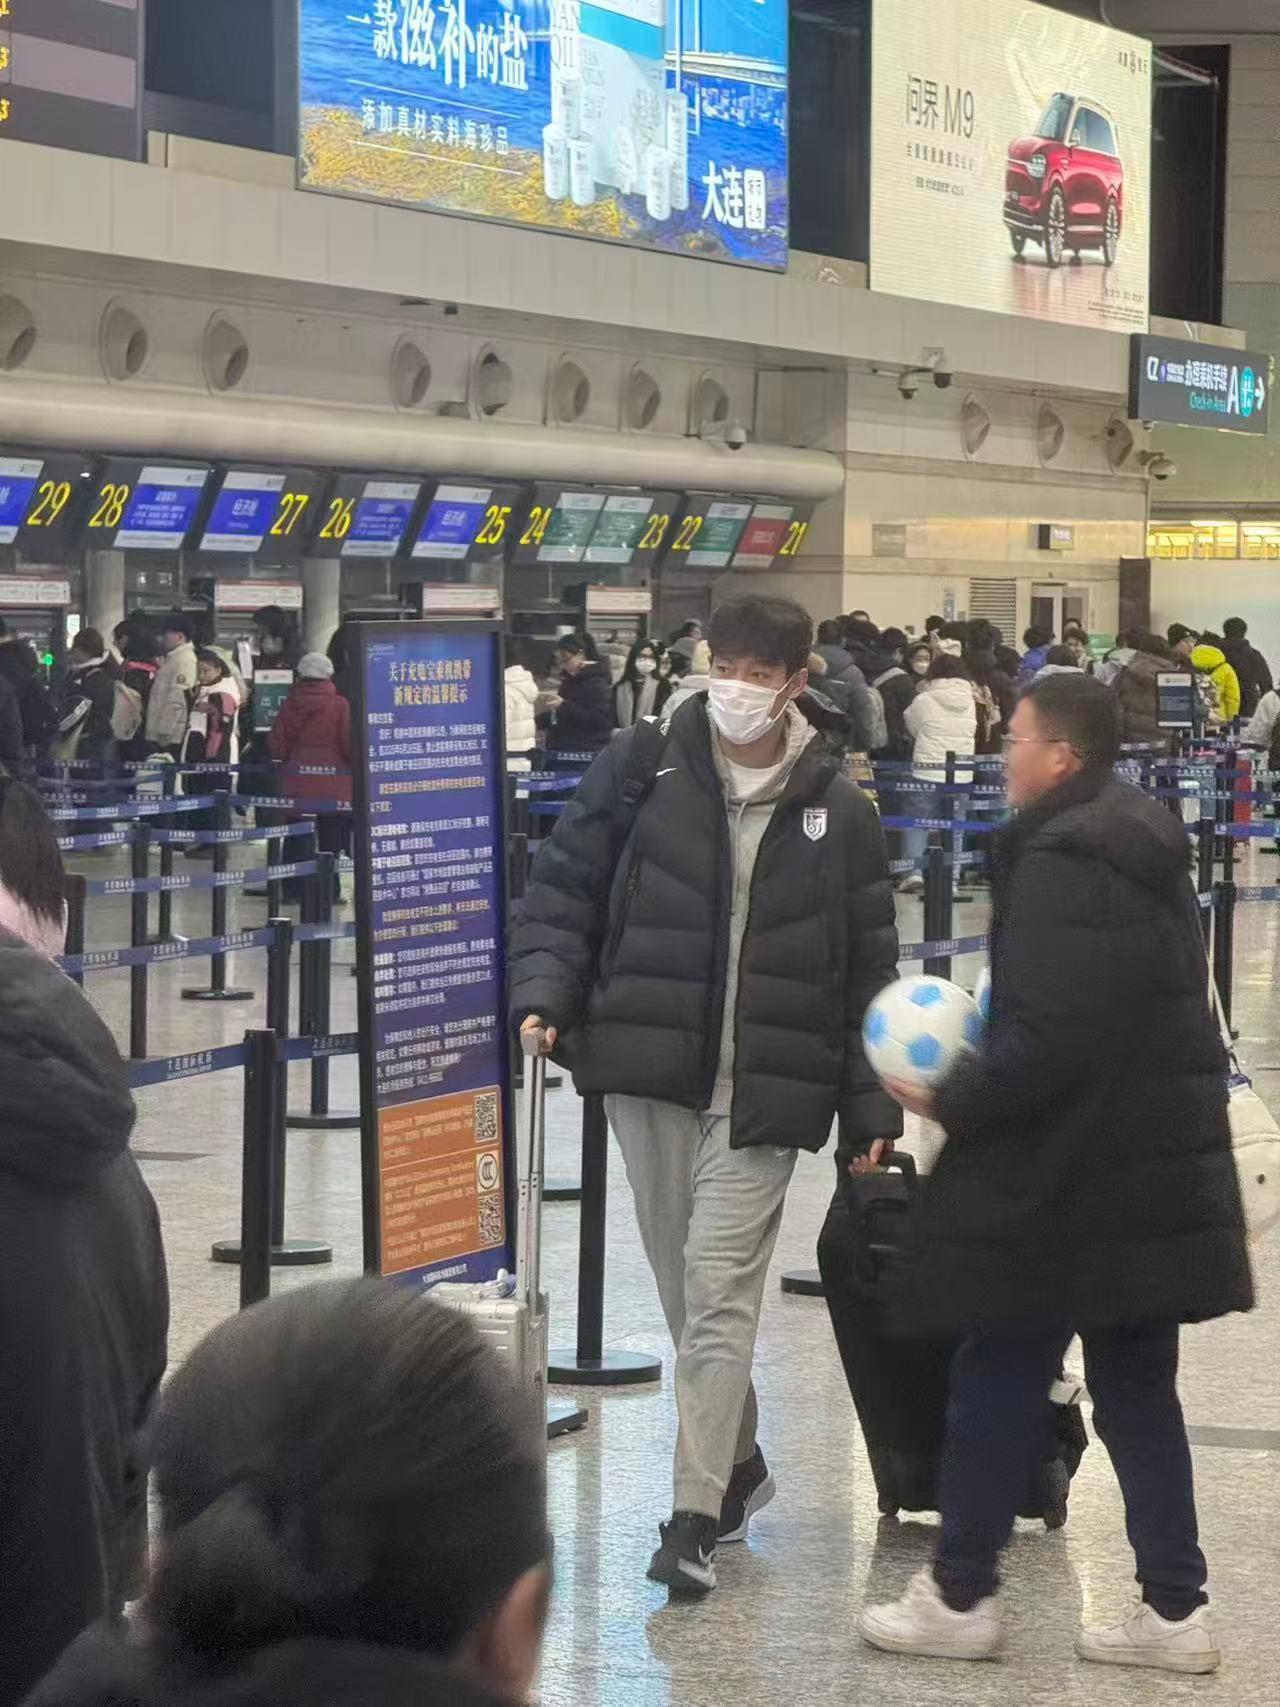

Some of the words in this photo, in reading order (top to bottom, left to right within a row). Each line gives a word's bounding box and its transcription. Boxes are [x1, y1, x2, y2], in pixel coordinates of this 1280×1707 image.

[346, 0, 528, 90] 一款滋补的盐
[362, 96, 508, 155] 添加真材实料海珍品
[906, 73, 939, 130] 问界
[944, 84, 974, 138] M9
[1227, 366, 1240, 415] A
[27, 481, 70, 526] 29
[88, 484, 129, 528] 28
[270, 493, 308, 535] 27
[319, 498, 355, 538] 26
[475, 505, 511, 544] 25
[519, 506, 552, 545] 24
[638, 514, 670, 549] 23
[672, 516, 702, 550] 22
[779, 521, 807, 555] 21
